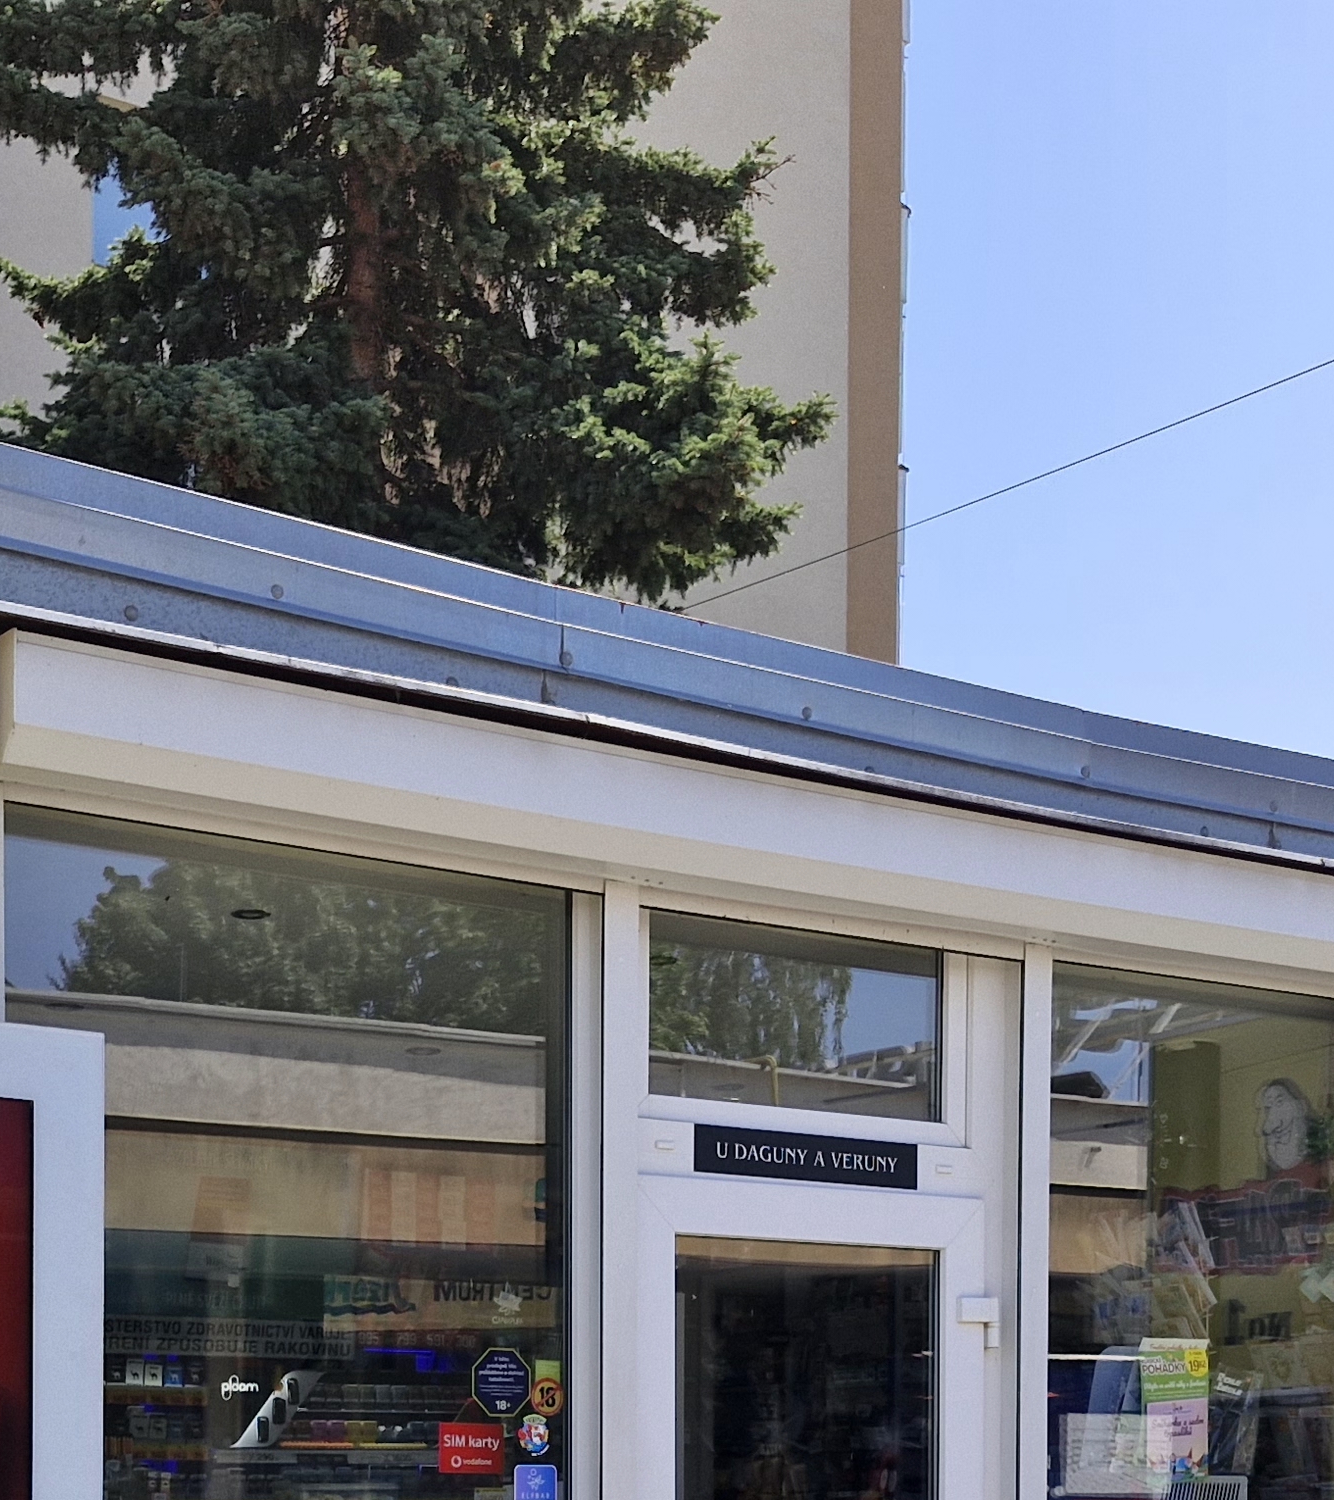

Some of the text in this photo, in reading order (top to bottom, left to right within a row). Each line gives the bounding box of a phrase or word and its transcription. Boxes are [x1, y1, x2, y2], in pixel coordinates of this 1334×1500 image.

[717, 1142, 899, 1173] U DAGUNY A VERUNY
[105, 1318, 181, 1335] STERSTVO
[264, 1341, 351, 1357] RAKOVINU
[443, 1434, 500, 1451] SIM karty
